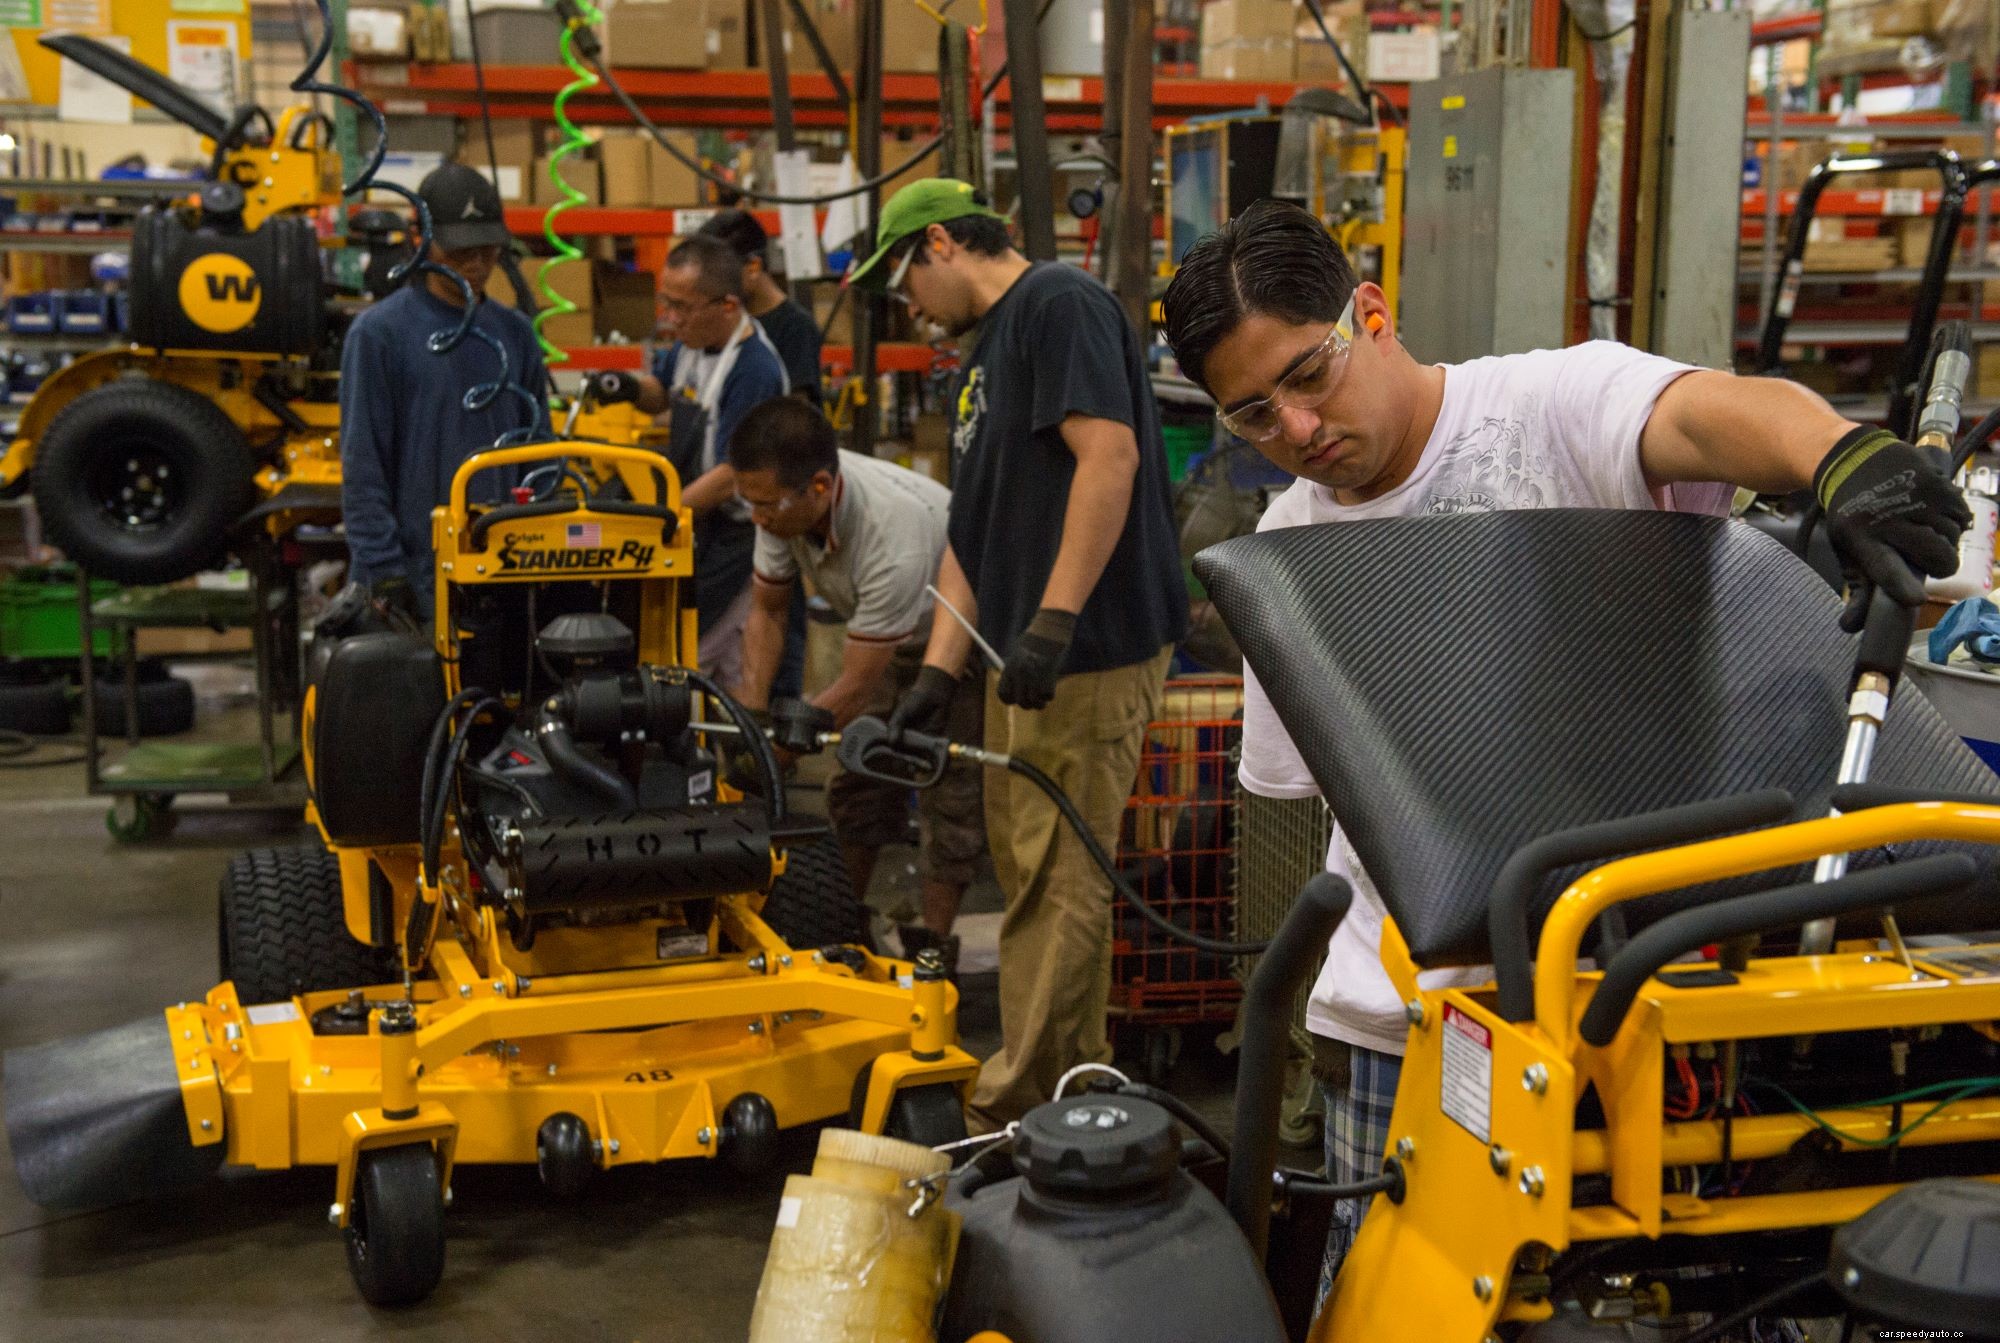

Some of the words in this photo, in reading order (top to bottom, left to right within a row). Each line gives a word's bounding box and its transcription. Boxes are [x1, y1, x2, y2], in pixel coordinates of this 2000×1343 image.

[205, 273, 261, 302] W
[497, 548, 615, 570] STANDER
[586, 828, 708, 862] HOT
[624, 1069, 674, 1083] 48
